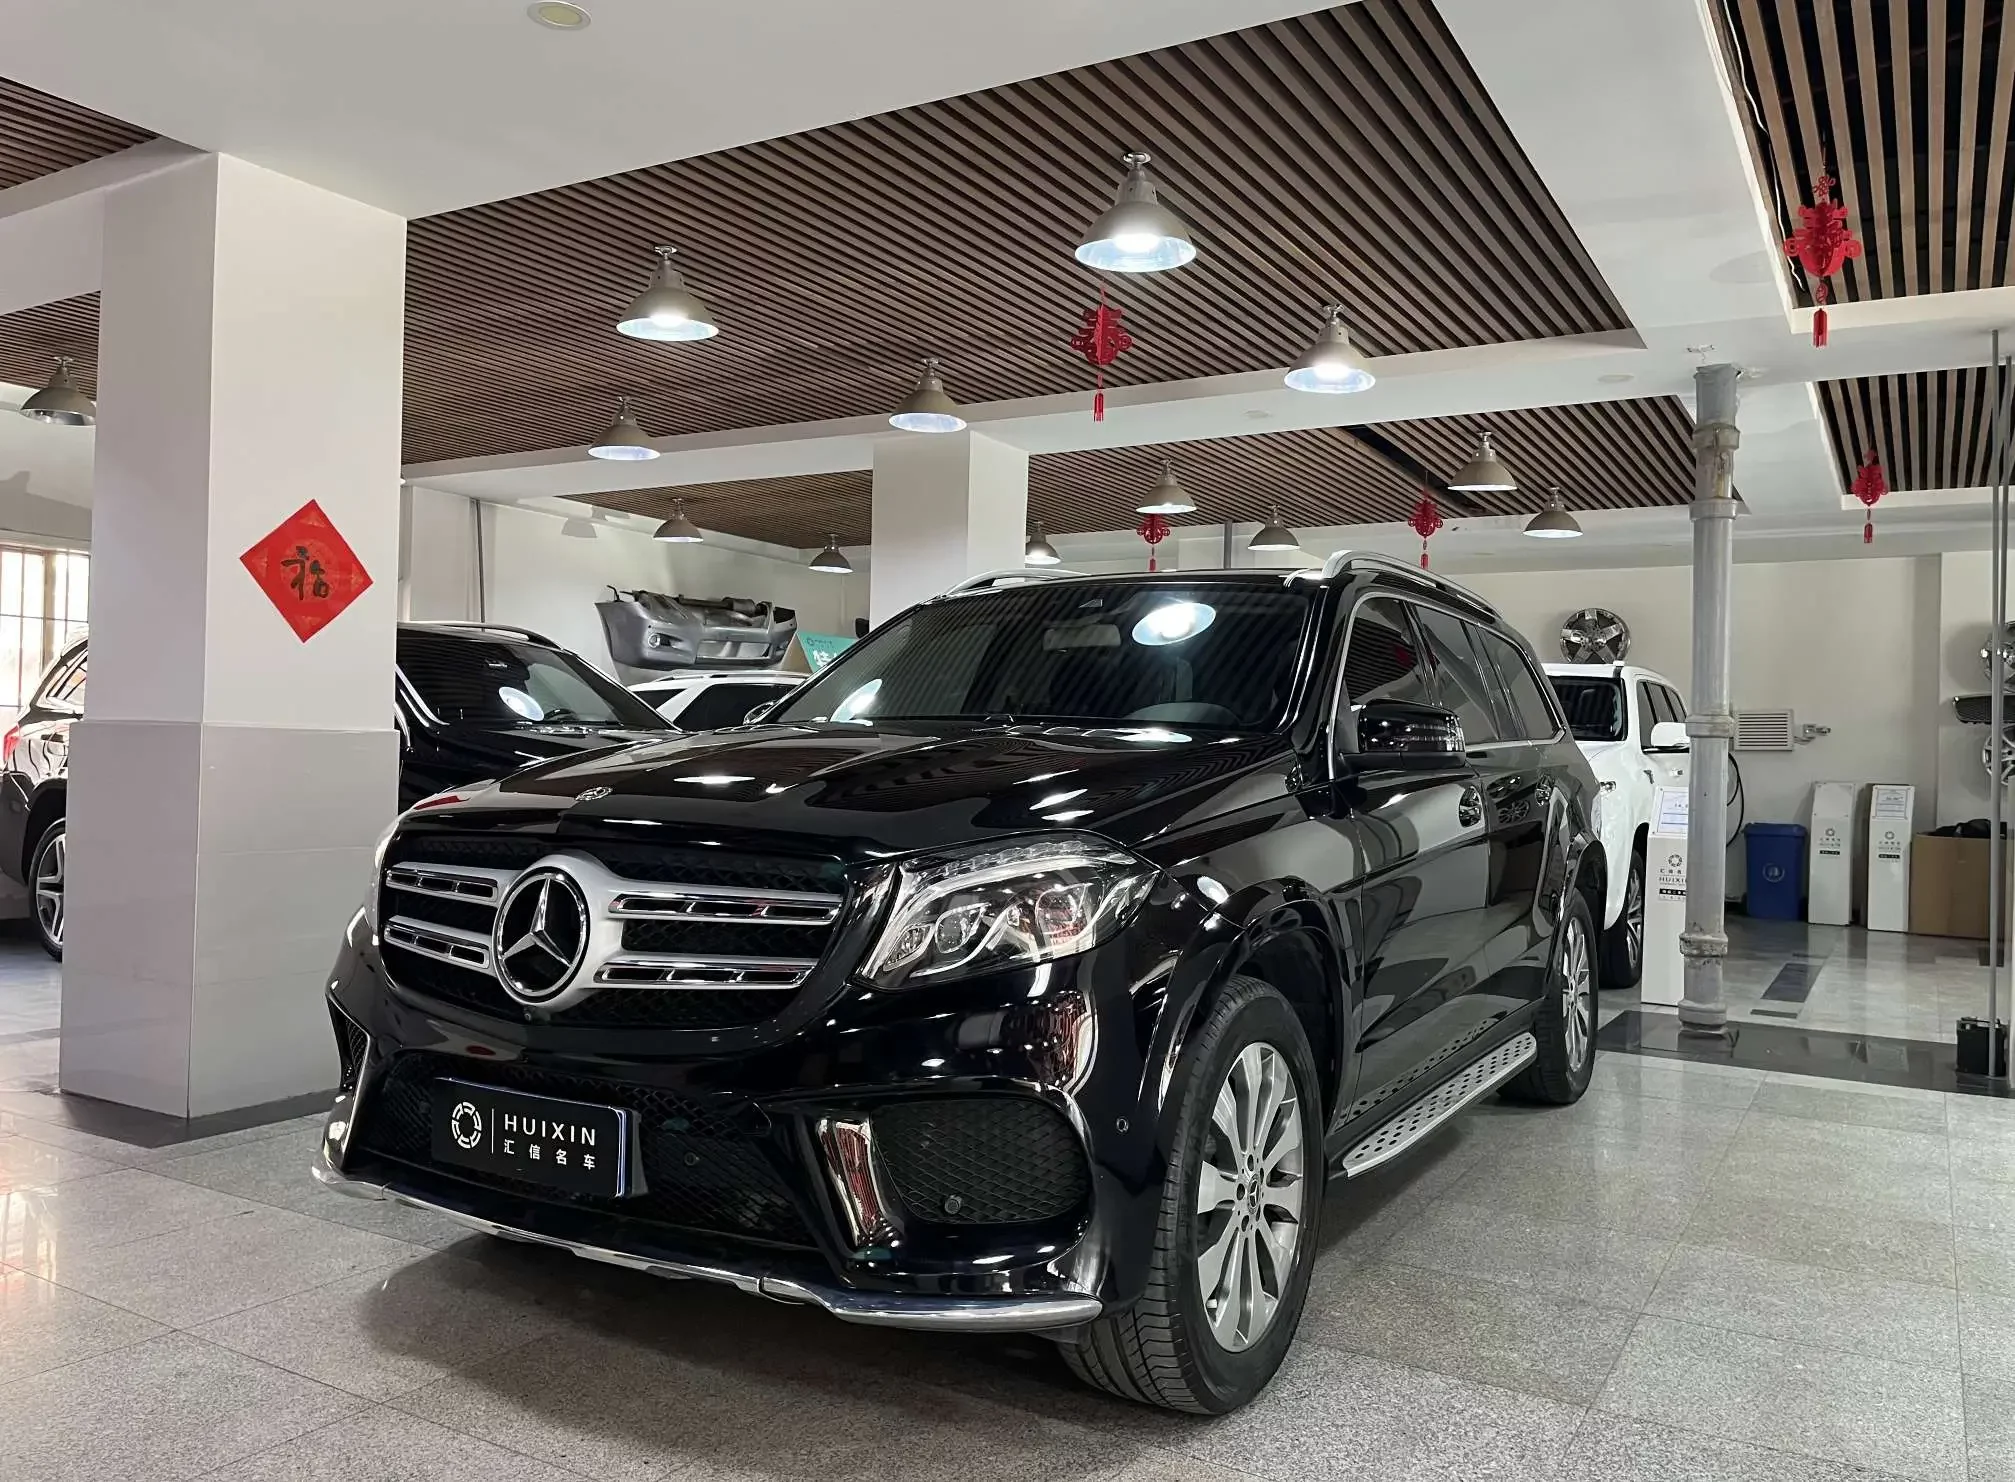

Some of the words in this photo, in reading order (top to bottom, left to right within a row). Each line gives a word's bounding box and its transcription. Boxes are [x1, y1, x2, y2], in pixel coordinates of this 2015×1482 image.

[281, 546, 330, 601] 福
[504, 1113, 596, 1146] HUIXIN
[503, 1139, 596, 1170] 汇信名车
